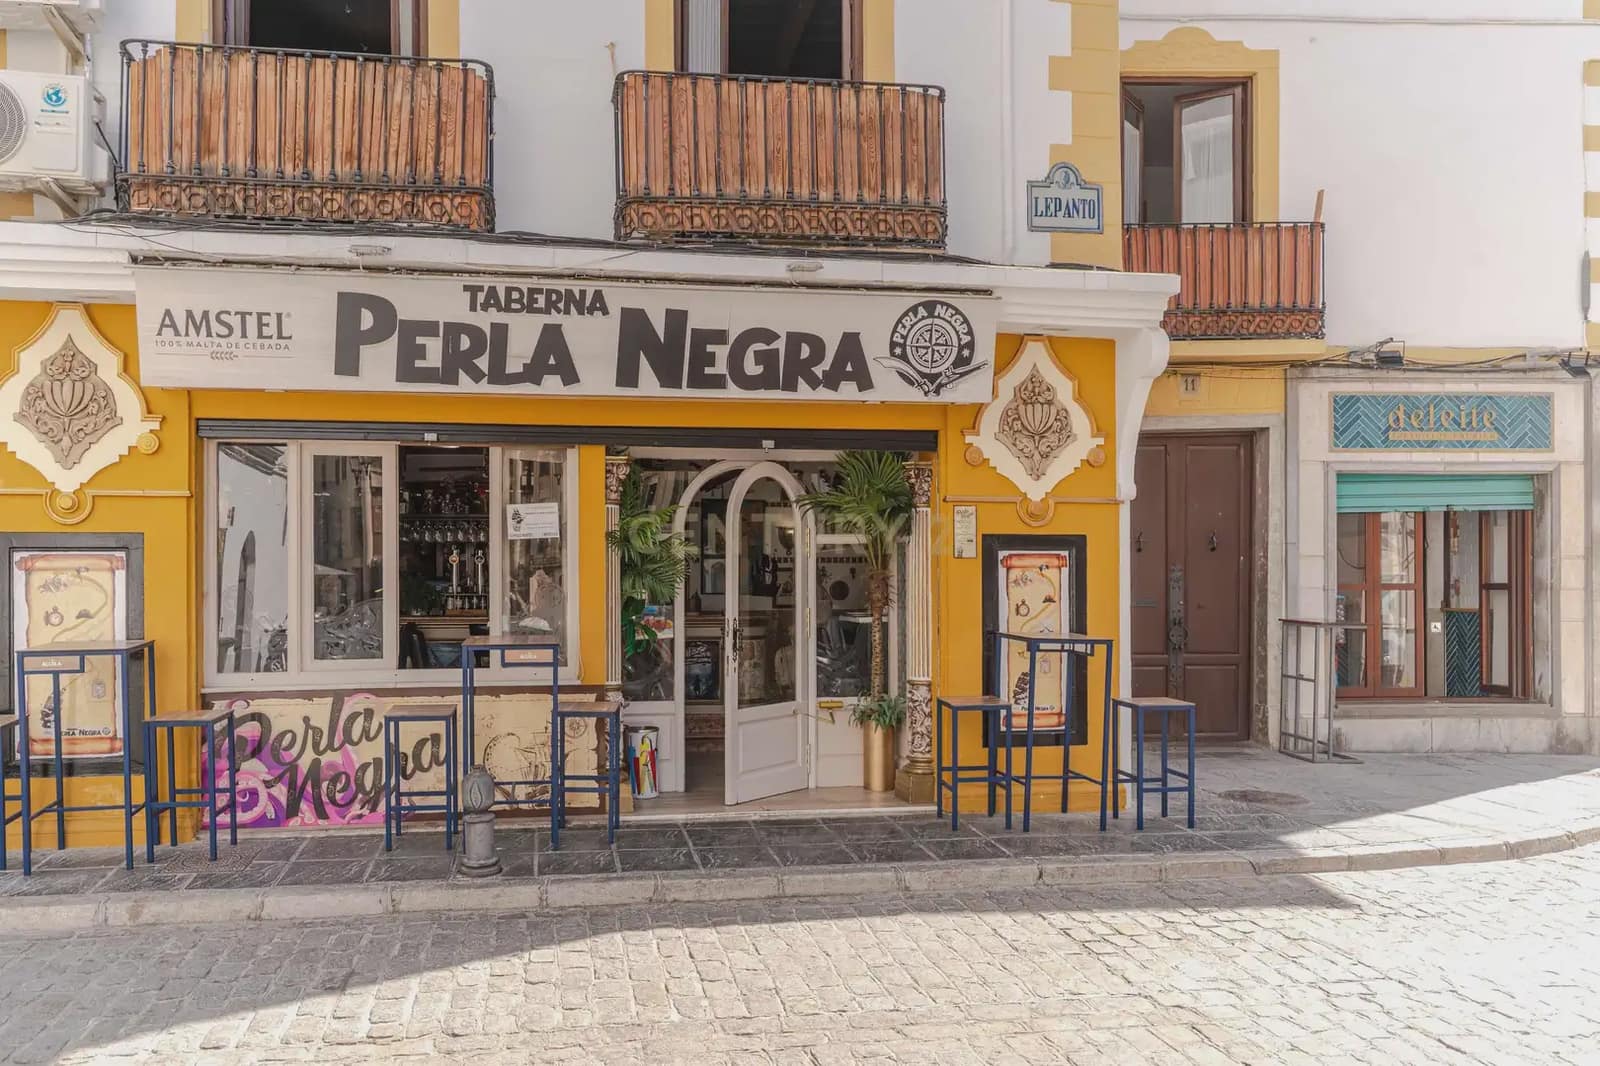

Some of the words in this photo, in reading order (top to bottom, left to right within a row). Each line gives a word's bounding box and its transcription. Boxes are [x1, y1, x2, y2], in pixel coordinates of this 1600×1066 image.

[1033, 196, 1096, 219] LEPANTO
[463, 284, 610, 316] TABERNA
[156, 308, 293, 340] AMSTEL
[893, 306, 928, 344] PERLA
[934, 304, 971, 345] NEGRA
[155, 340, 182, 348] 100%
[186, 341, 222, 350] MALTA
[244, 342, 290, 351] CEBADA
[334, 291, 581, 386] PERLA
[615, 307, 874, 392] NEGRA
[1184, 378, 1195, 392] 11
[1388, 402, 1496, 429] deleite
[212, 690, 384, 772] Perla
[262, 732, 448, 820] Negra
